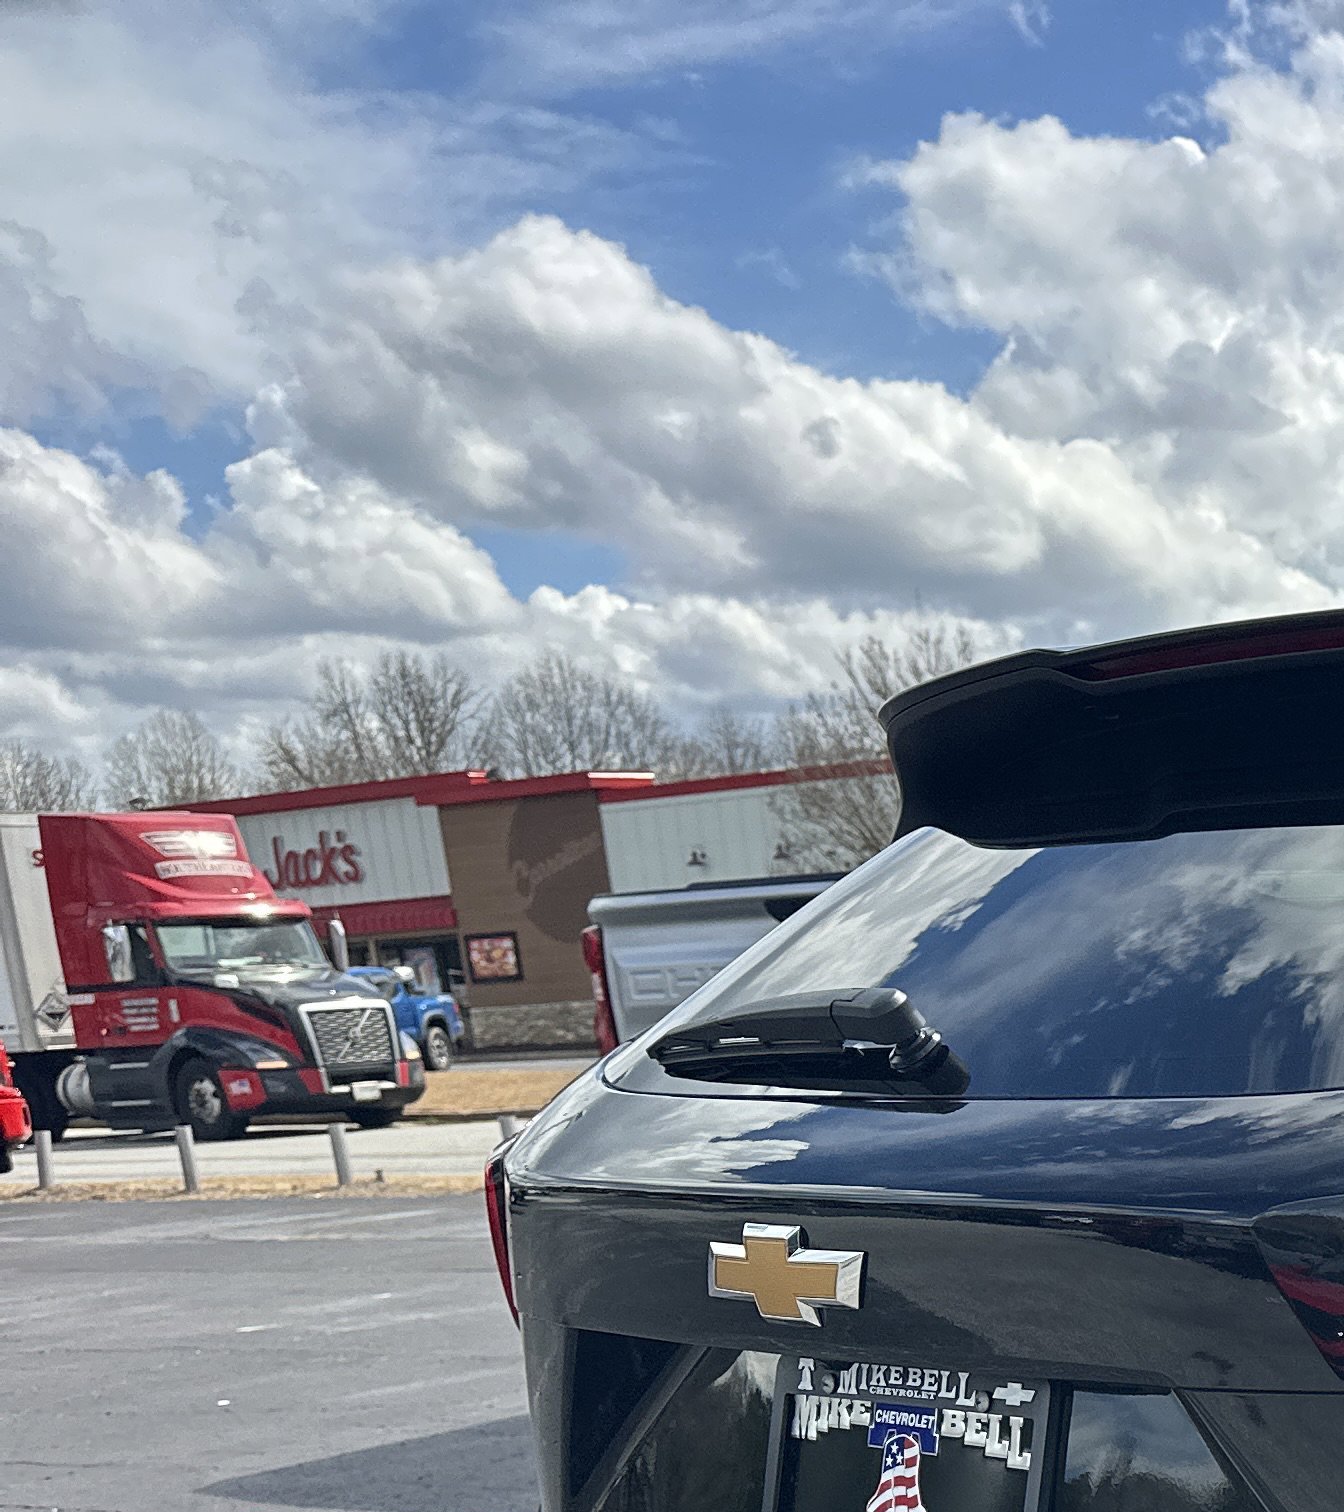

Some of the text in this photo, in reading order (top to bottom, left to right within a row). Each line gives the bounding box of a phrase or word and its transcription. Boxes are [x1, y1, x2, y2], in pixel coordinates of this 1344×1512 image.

[262, 831, 363, 890] Jack's
[869, 1386, 937, 1400] CHEVROLET
[792, 1394, 1032, 1470] MIKE BELL
[875, 1408, 935, 1430] CHEVROLET
